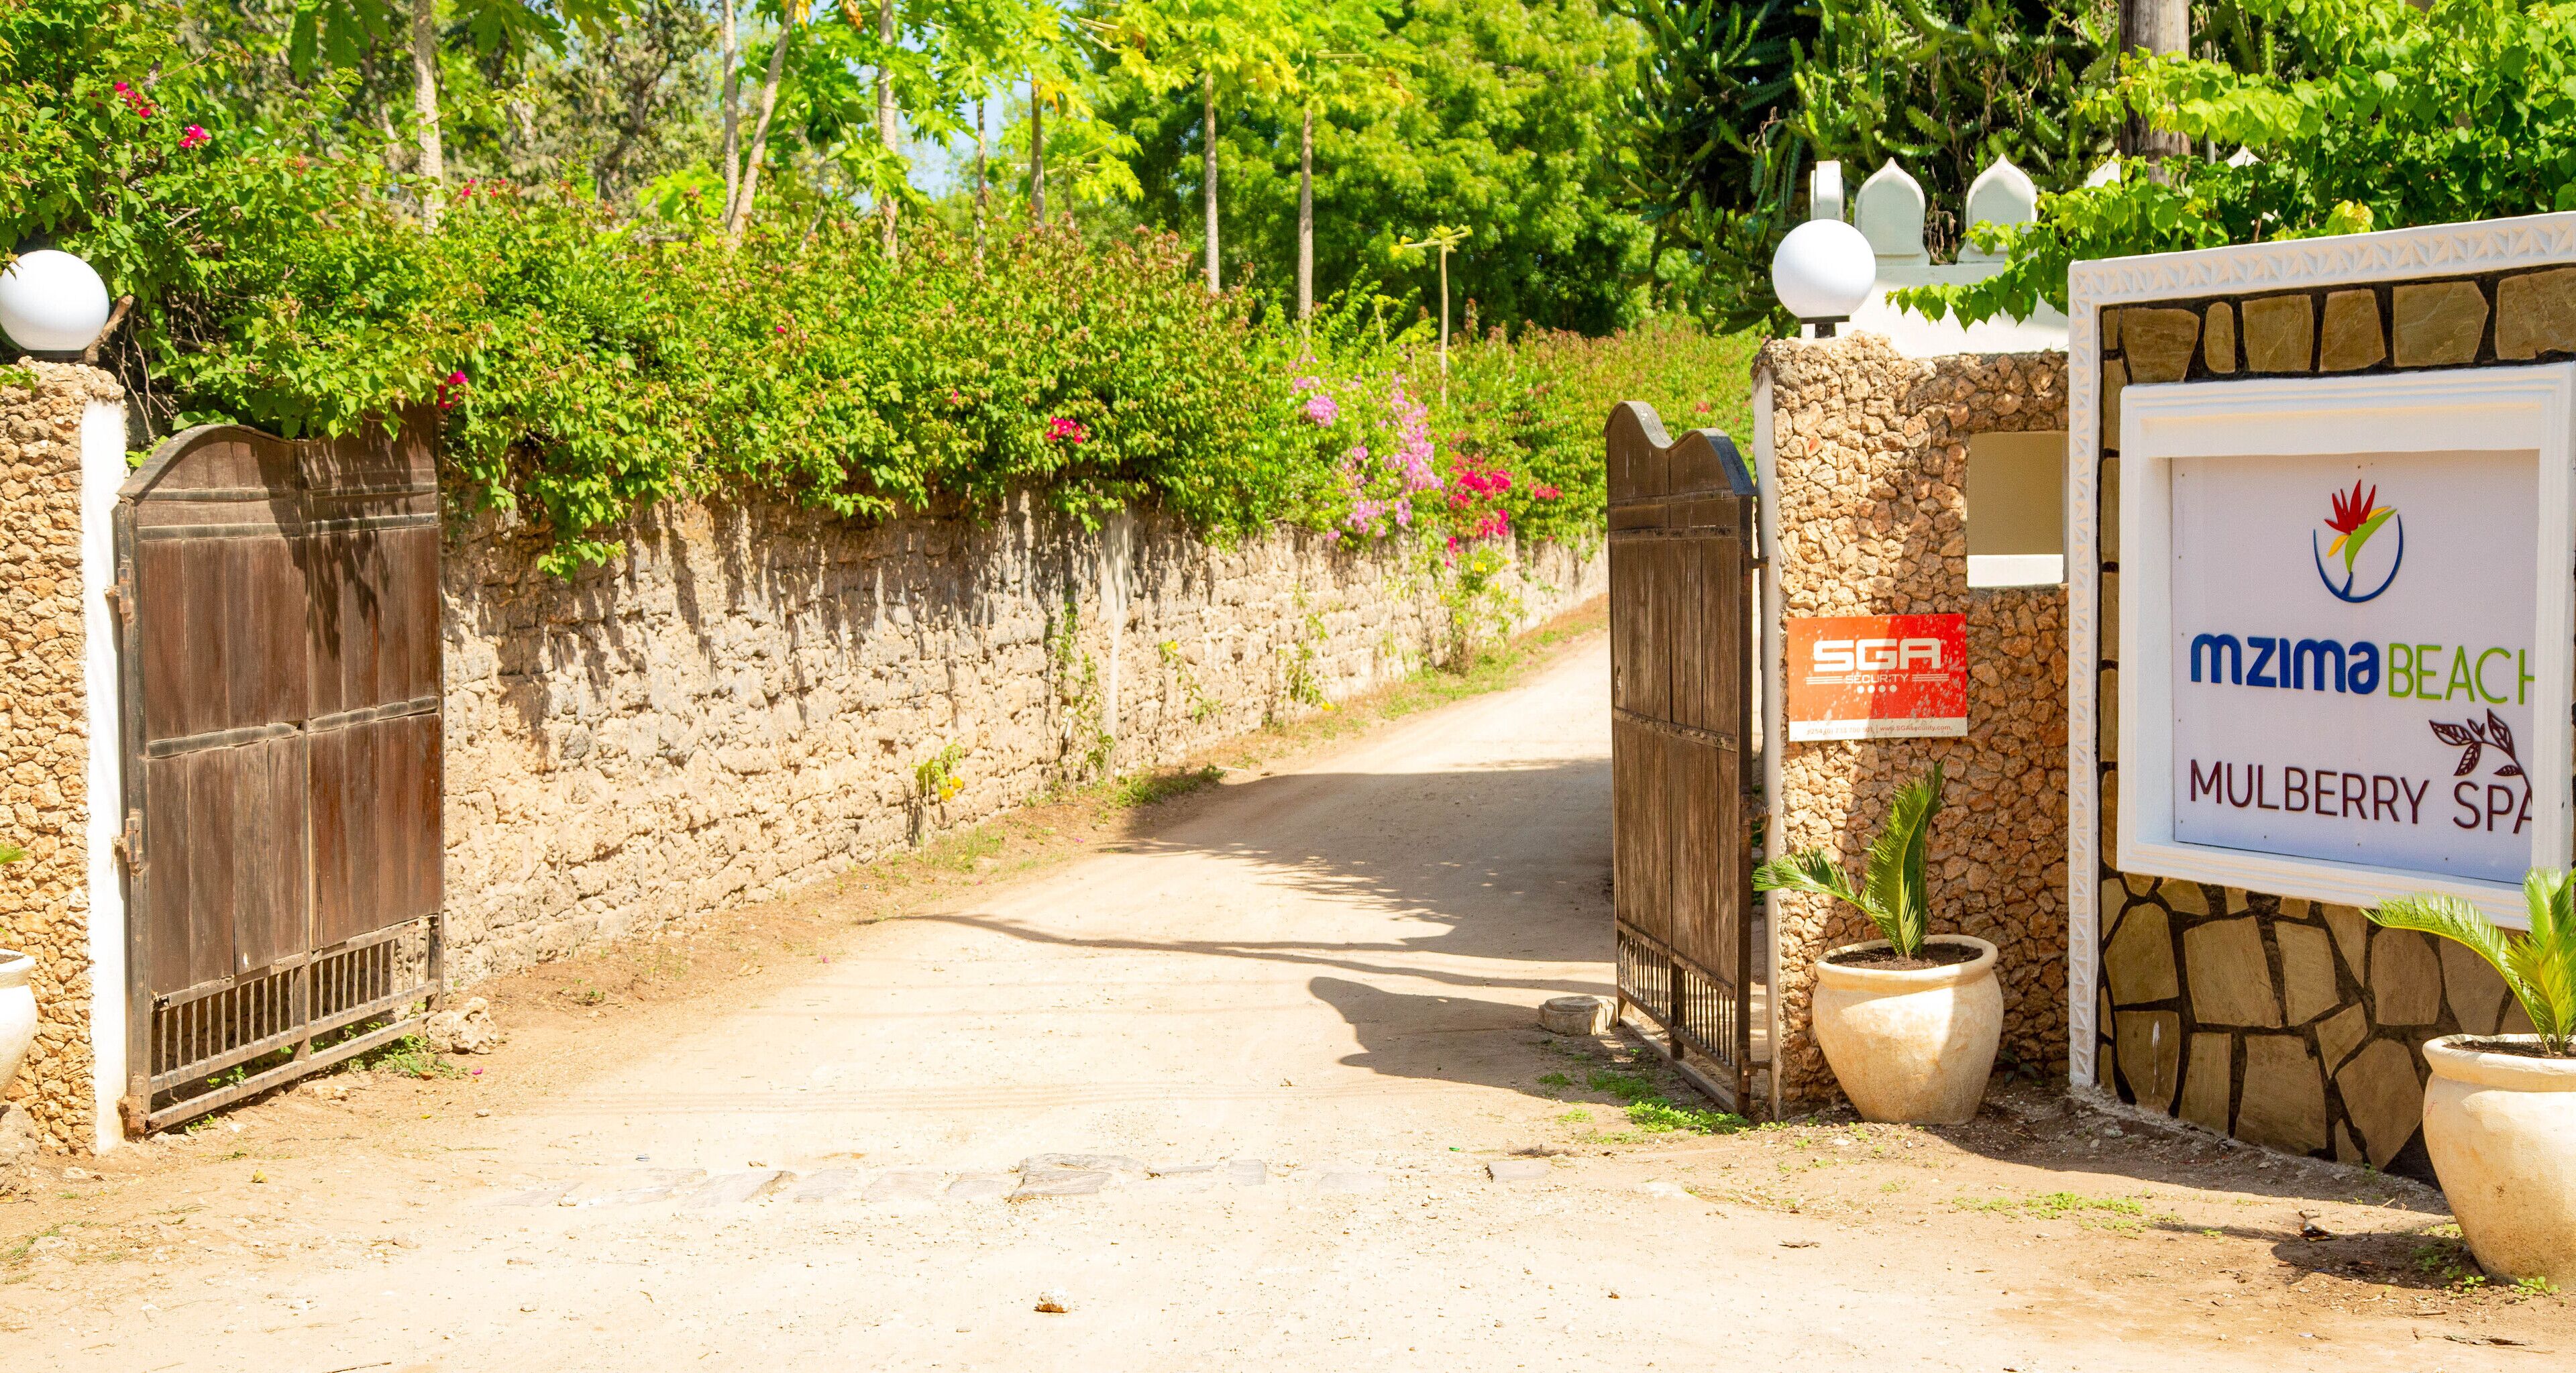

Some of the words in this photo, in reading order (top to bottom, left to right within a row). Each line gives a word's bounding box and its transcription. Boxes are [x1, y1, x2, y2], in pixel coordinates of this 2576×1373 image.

[1813, 637, 1941, 672] SGA
[1844, 673, 1909, 684] SECURITY
[2190, 633, 2380, 696] mzima
[2190, 758, 2430, 825] MULBERRY
